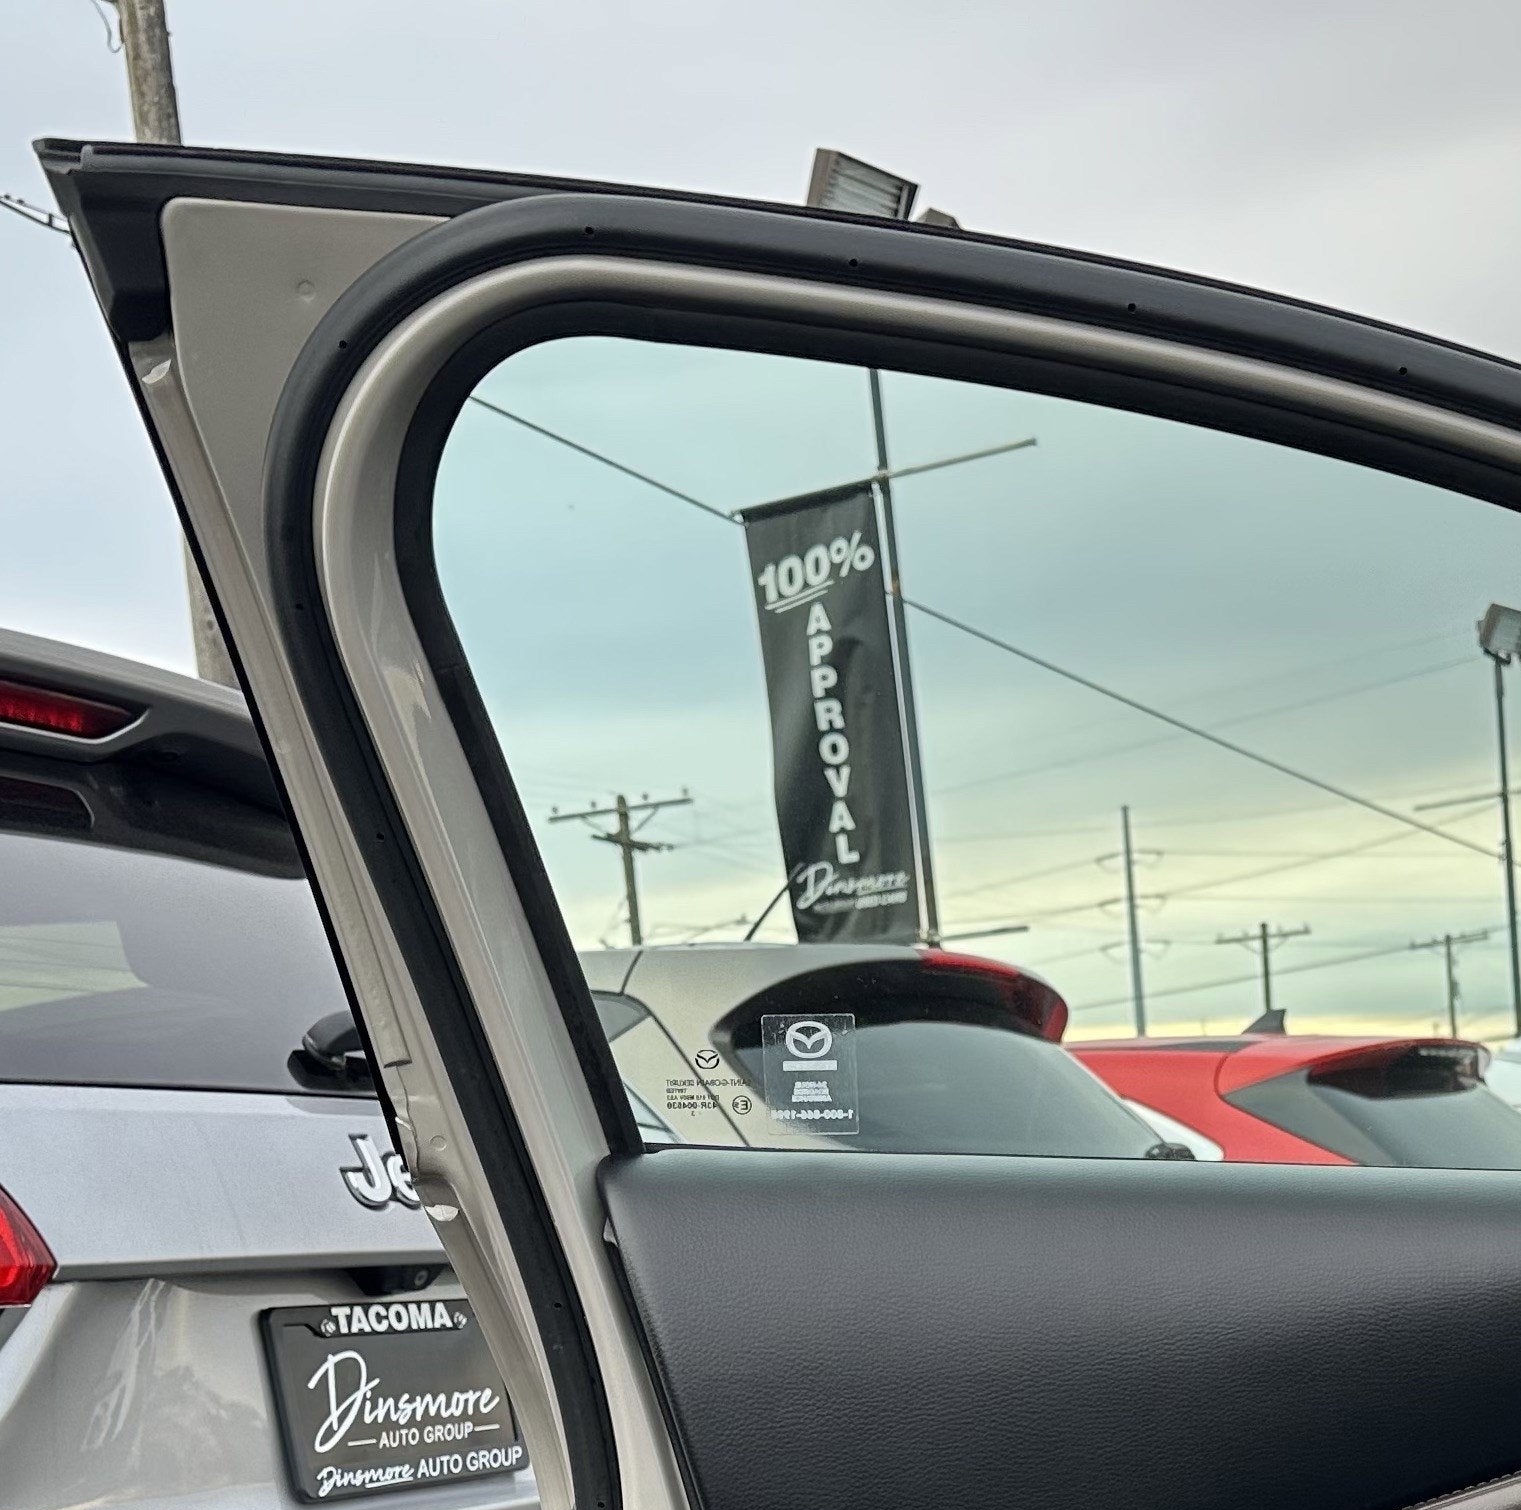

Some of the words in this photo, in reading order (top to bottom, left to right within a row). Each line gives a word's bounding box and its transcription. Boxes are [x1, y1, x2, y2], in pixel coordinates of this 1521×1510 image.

[758, 529, 875, 601] 100%
[805, 601, 861, 865] APPROVAL
[330, 1301, 454, 1334] TACOMA
[307, 1350, 500, 1453] Dinsmore
[379, 1426, 420, 1449] AUTO
[423, 1422, 475, 1445] GROUP
[317, 1463, 415, 1497] Dinsmore
[416, 1454, 464, 1479] AUTO
[466, 1445, 523, 1473] GROUP
